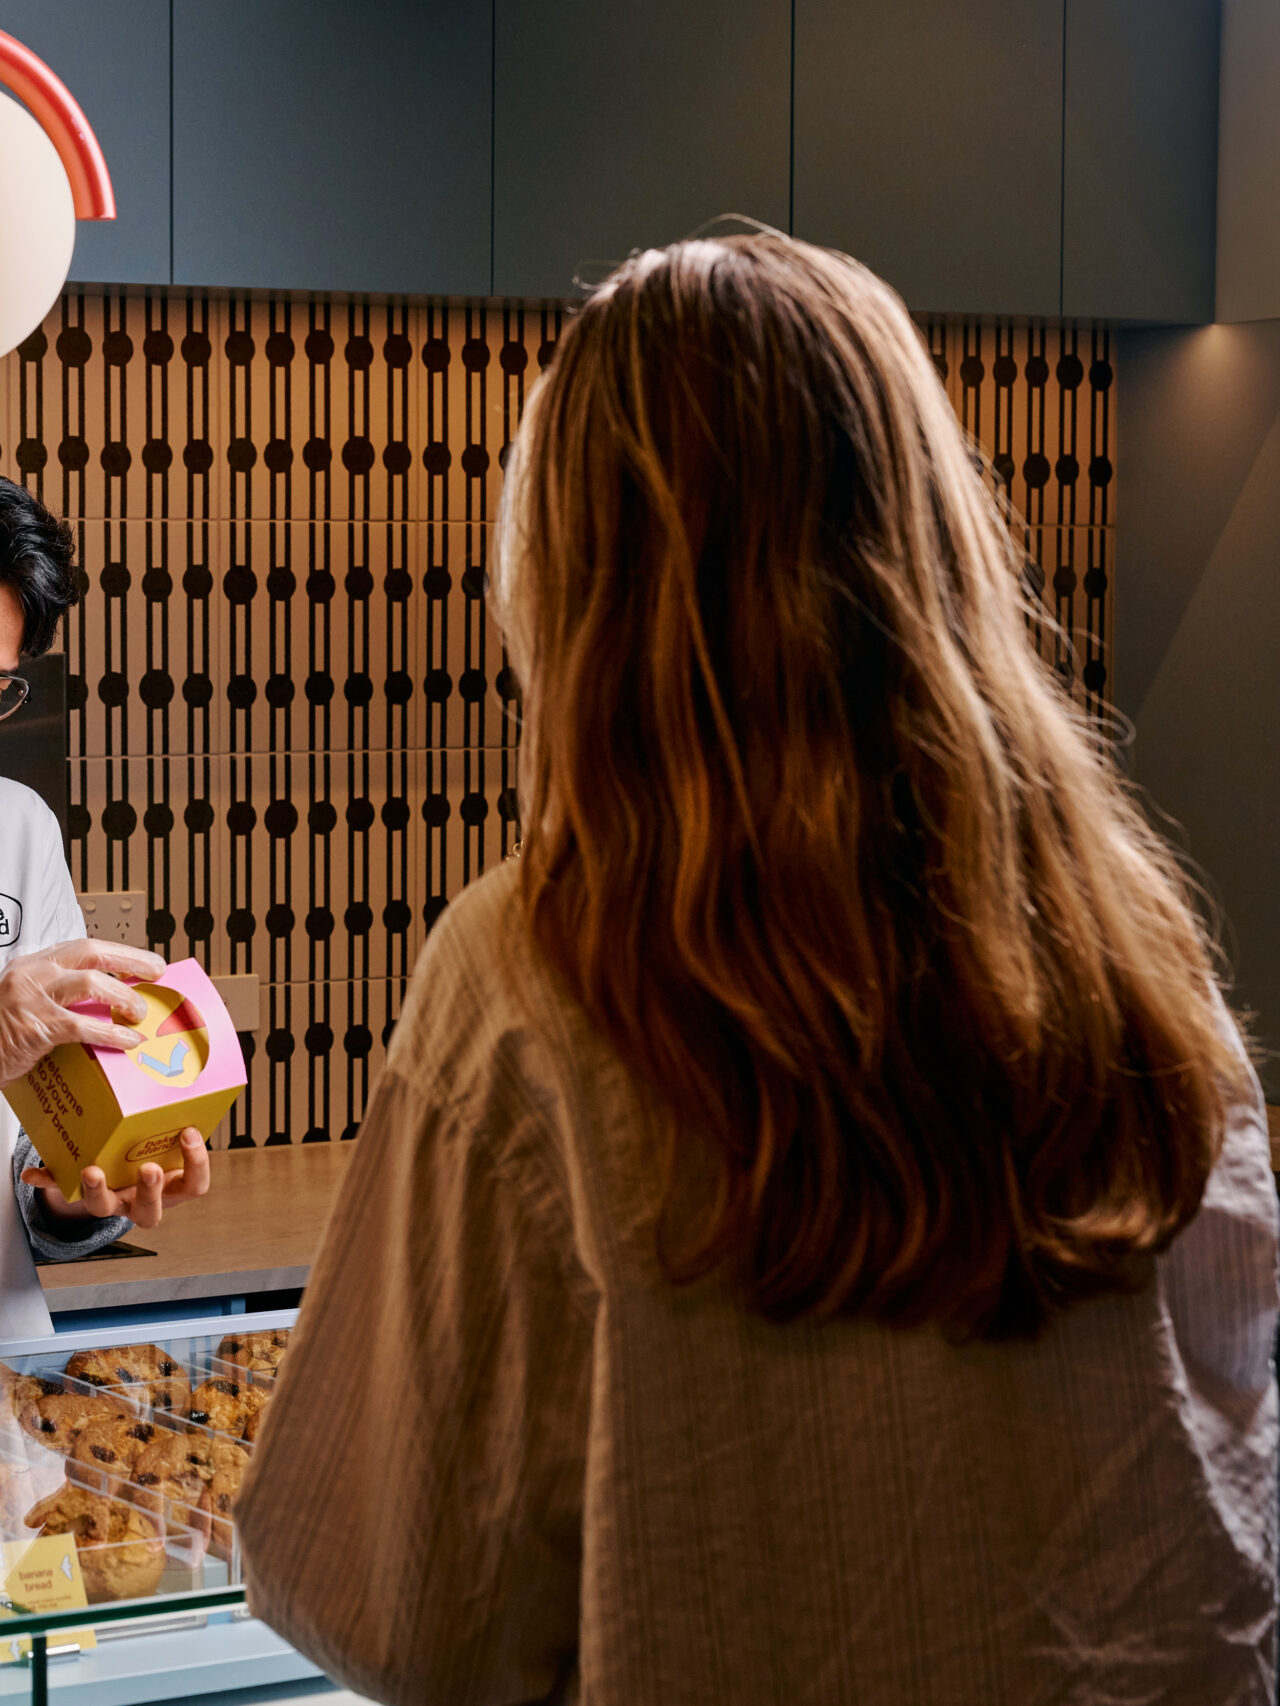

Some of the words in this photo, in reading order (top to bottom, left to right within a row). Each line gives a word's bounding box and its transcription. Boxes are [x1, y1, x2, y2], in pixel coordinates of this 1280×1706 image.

[46, 1079, 69, 1117] your
[27, 1071, 54, 1115] eality
[51, 1113, 81, 1162] break
[18, 1568, 54, 1581] banana
[24, 1580, 53, 1592] bread
